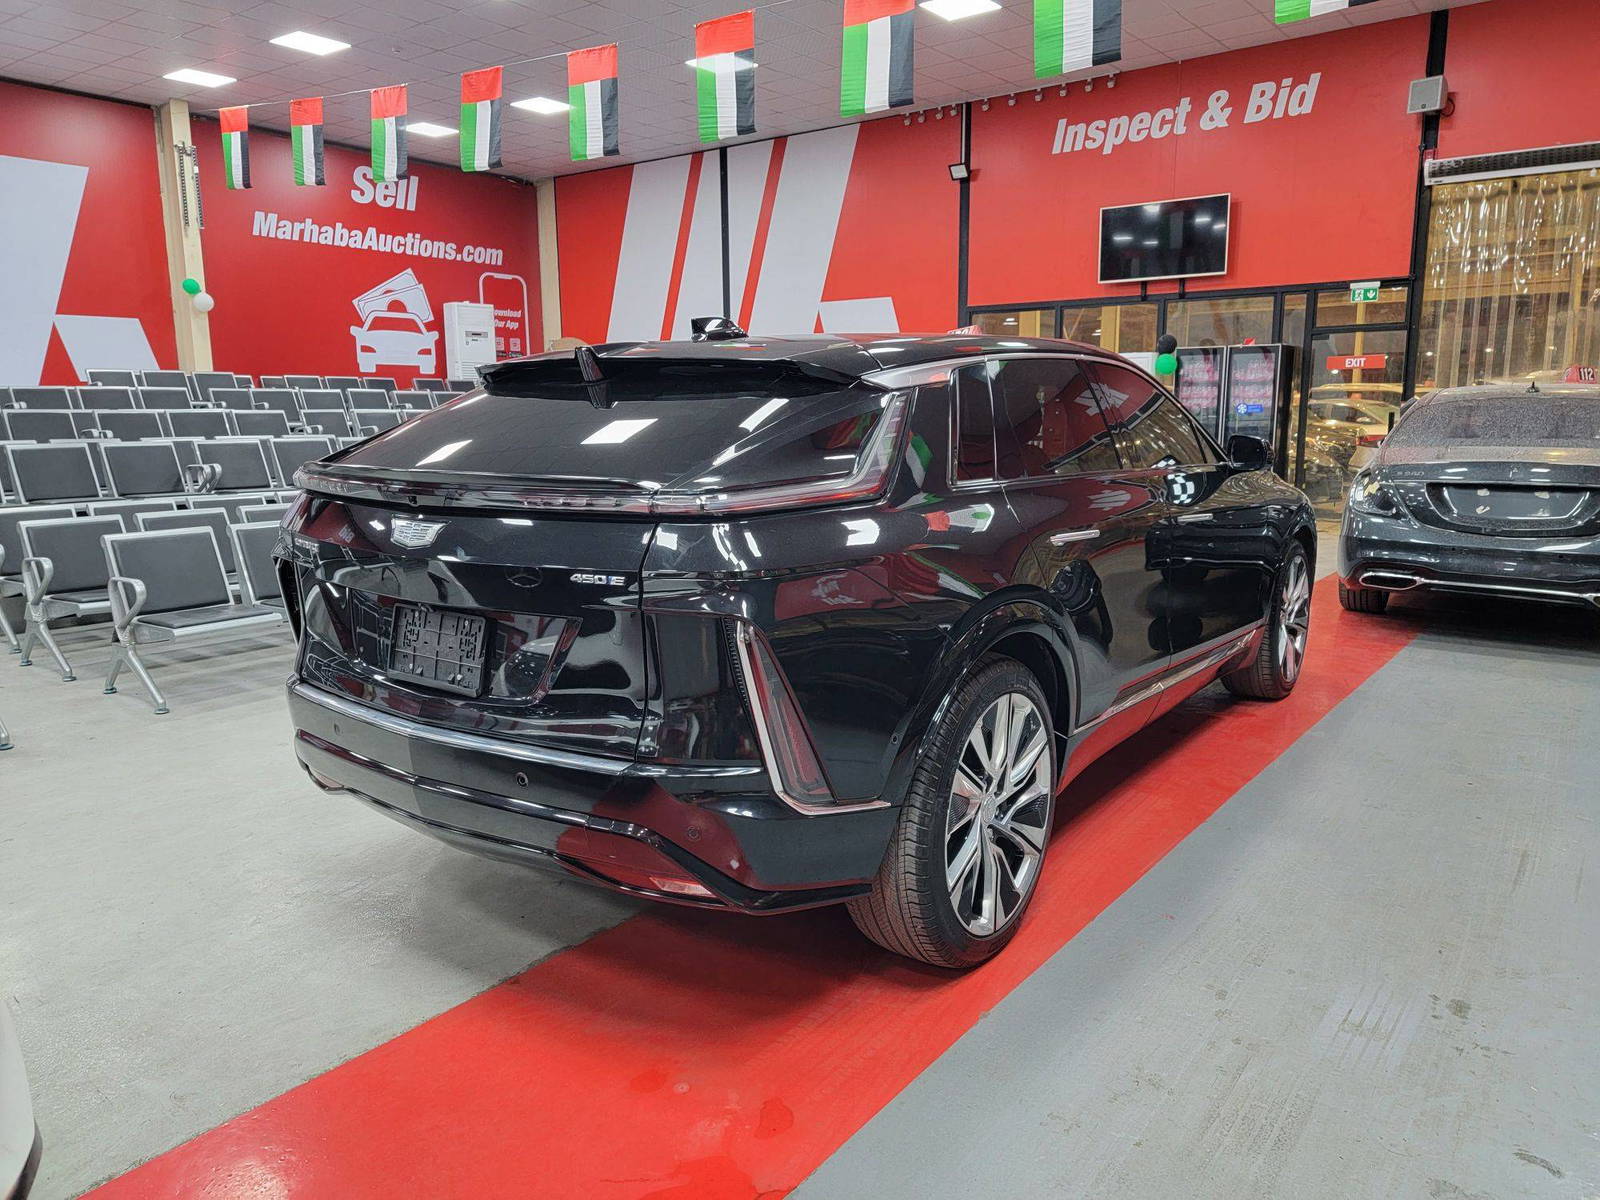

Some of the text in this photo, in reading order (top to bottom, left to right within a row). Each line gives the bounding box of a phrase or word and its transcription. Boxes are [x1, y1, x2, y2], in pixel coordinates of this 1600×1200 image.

[1052, 72, 1322, 154] Inspect & Bid
[351, 166, 418, 211] Sell
[252, 211, 503, 265] MarhabaAuctions.com
[494, 309, 521, 318] ownload
[1345, 357, 1366, 368] EXIT
[1579, 367, 1594, 381] 112
